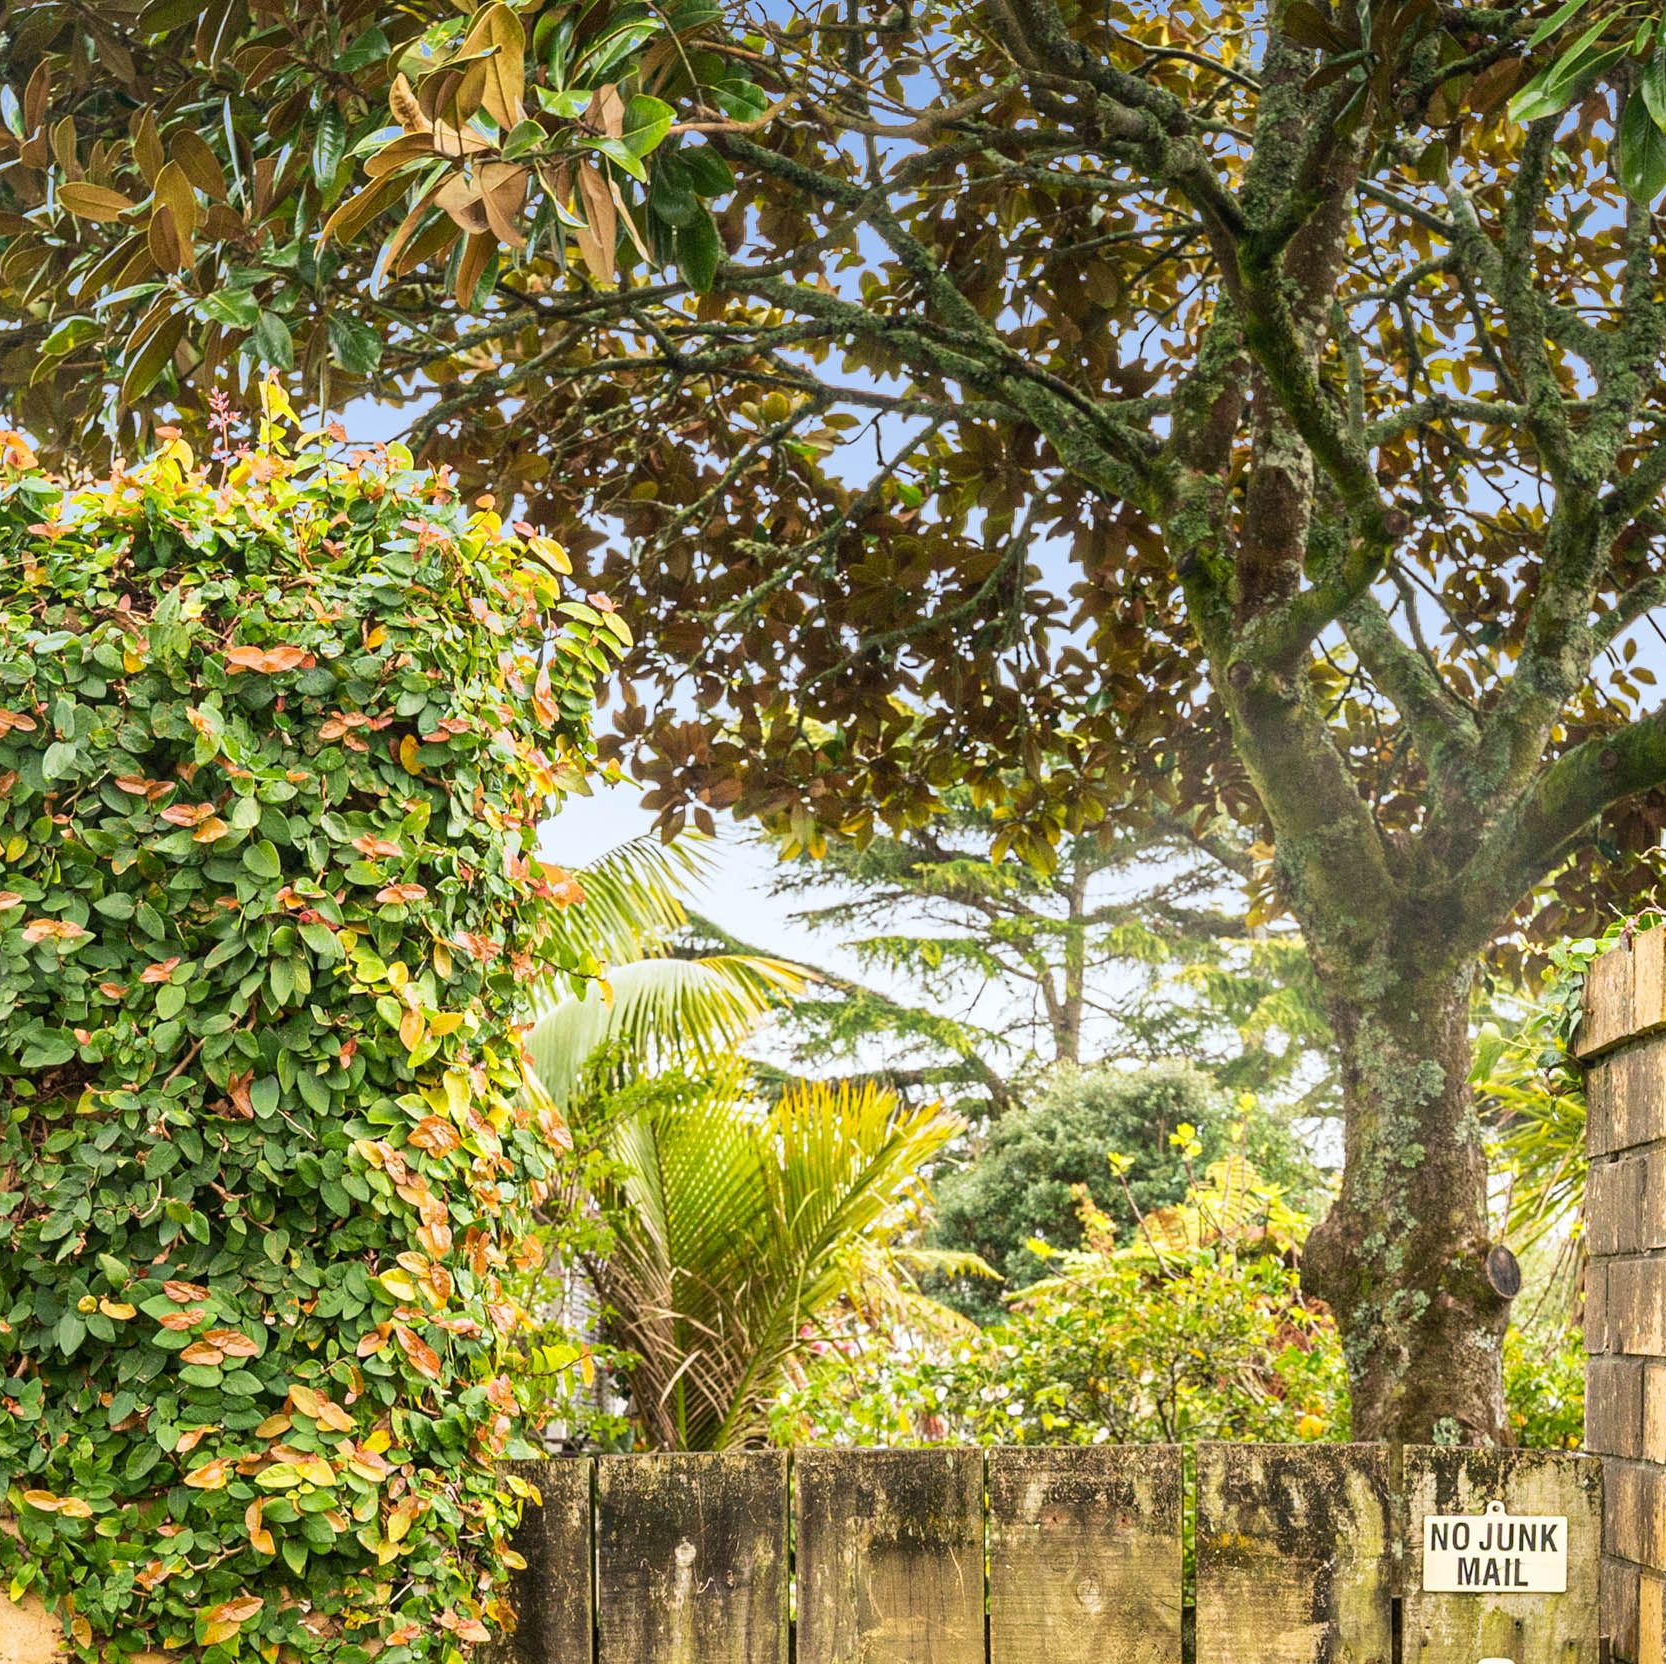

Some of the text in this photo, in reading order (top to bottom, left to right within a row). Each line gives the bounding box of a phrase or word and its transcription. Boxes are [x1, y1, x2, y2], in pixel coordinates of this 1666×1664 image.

[1431, 1522, 1559, 1553] NO JUNK
[1456, 1557, 1529, 1587] MAIL
